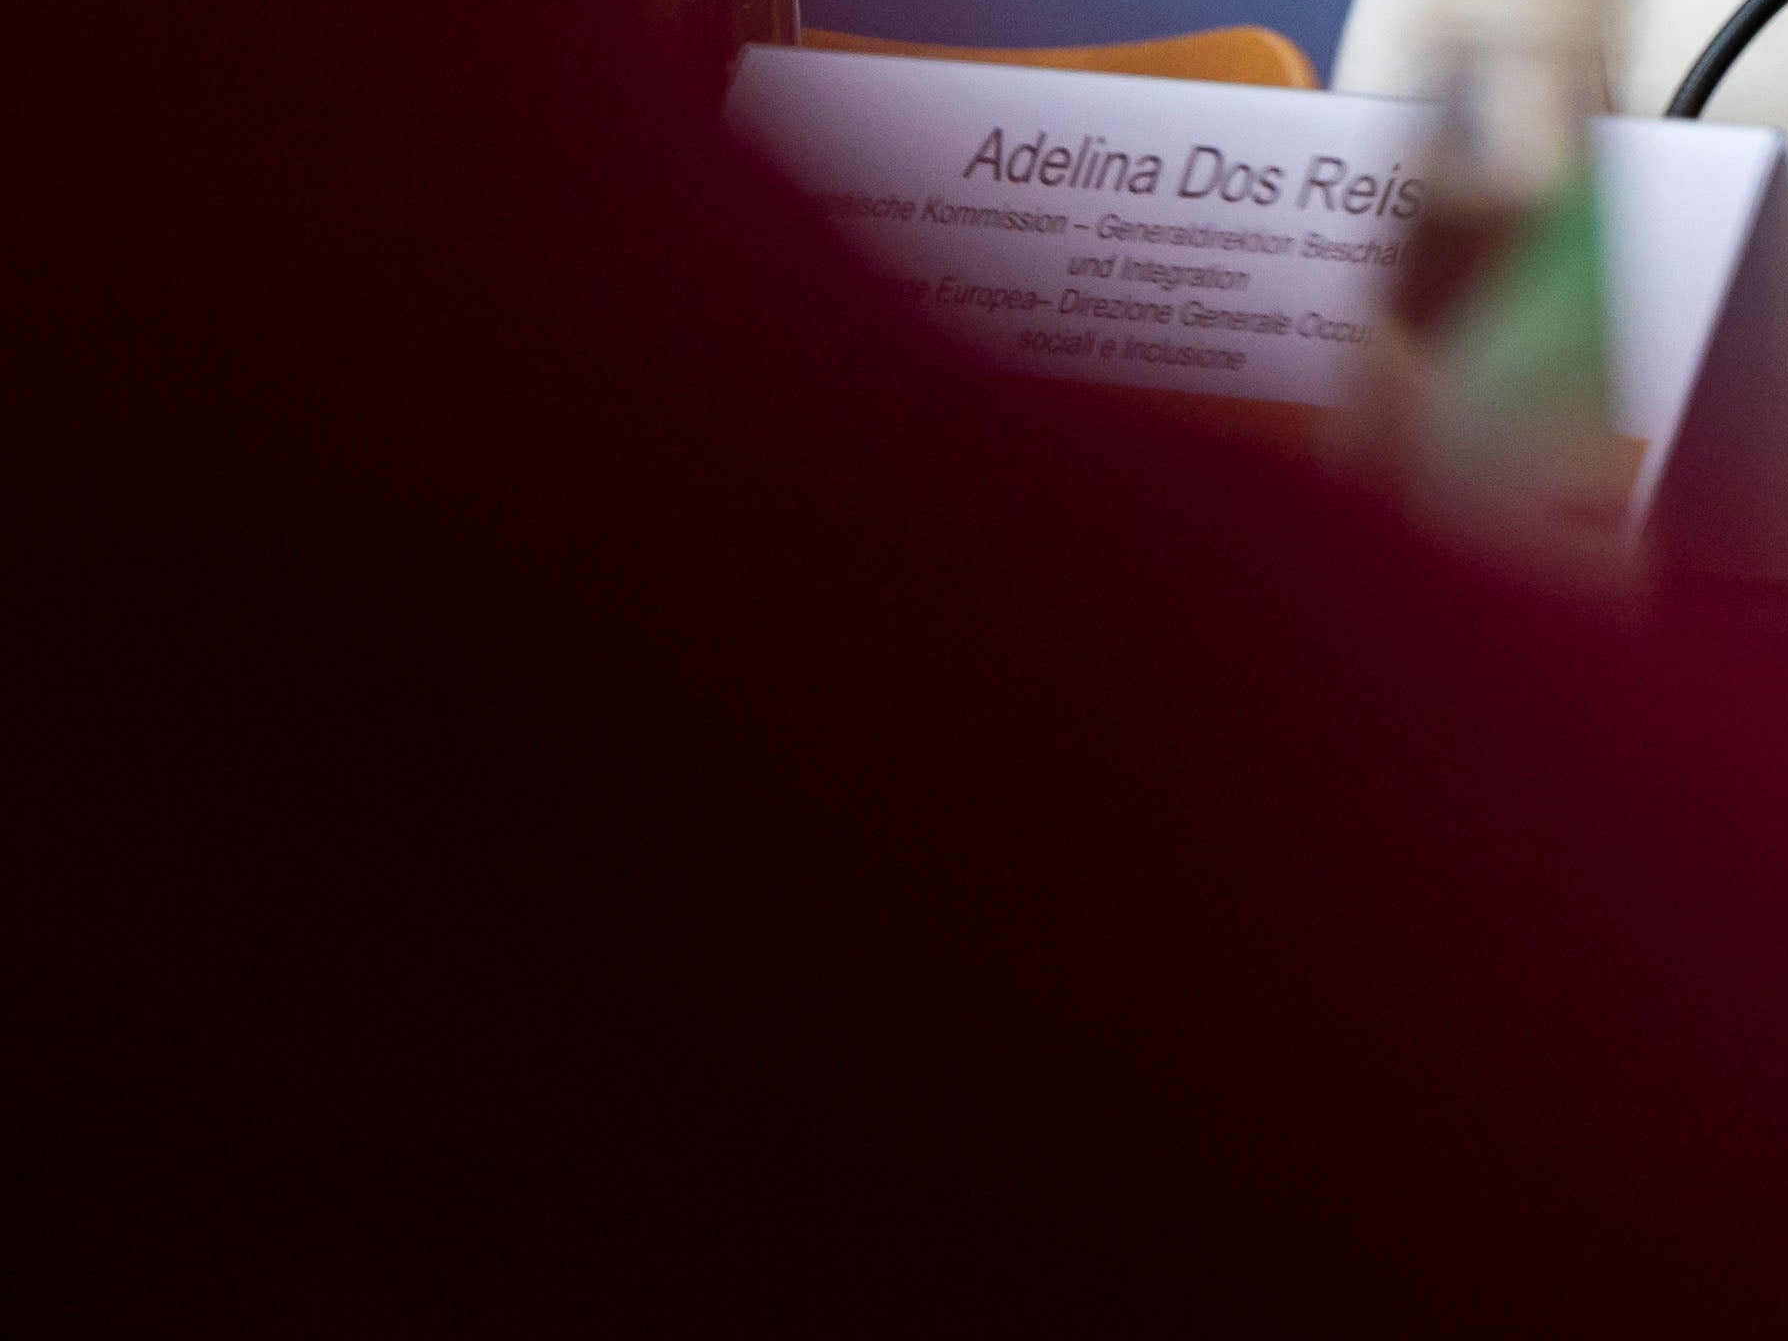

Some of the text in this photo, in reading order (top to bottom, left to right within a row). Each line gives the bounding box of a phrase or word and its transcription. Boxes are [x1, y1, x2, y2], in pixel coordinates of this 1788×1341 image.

[962, 126, 1425, 218] Adelina Dos Reis
[922, 196, 1068, 235] Kommission
[1067, 254, 1250, 292] und Integration
[1057, 287, 1174, 325] Direzione
[1182, 300, 1293, 337] Generale
[1020, 329, 1248, 371] sociali e Inclusione
